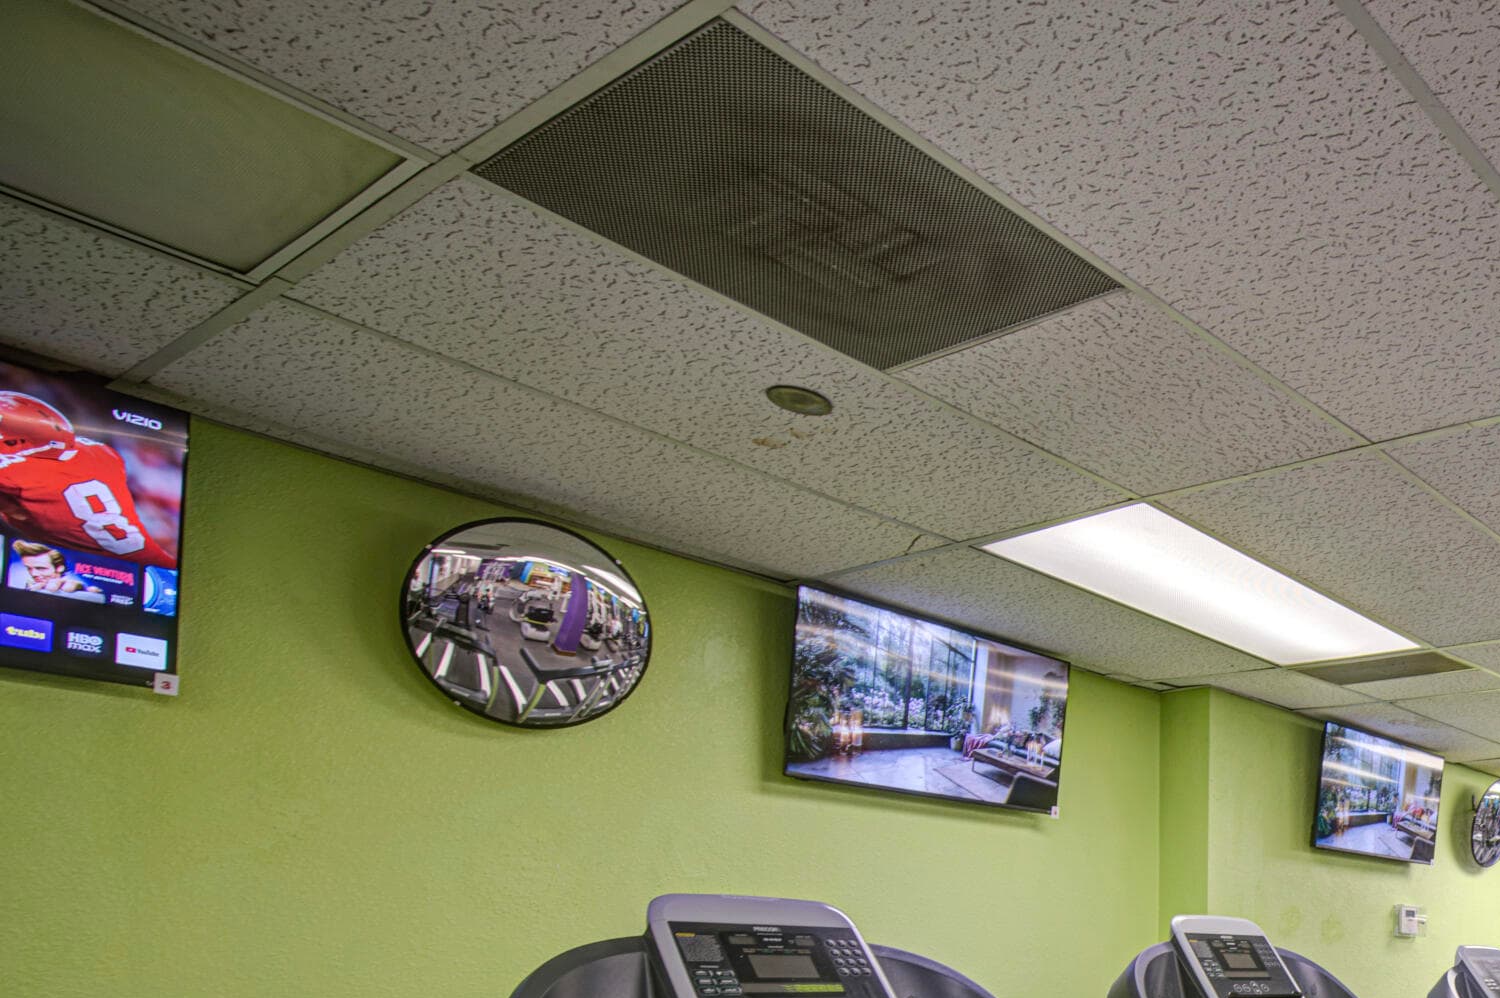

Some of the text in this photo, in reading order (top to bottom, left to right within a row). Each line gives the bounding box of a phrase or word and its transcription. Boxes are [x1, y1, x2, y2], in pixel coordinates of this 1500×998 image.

[112, 409, 162, 430] VIZIO
[63, 479, 145, 555] 8
[67, 632, 103, 646] HBO
[67, 642, 102, 653] max
